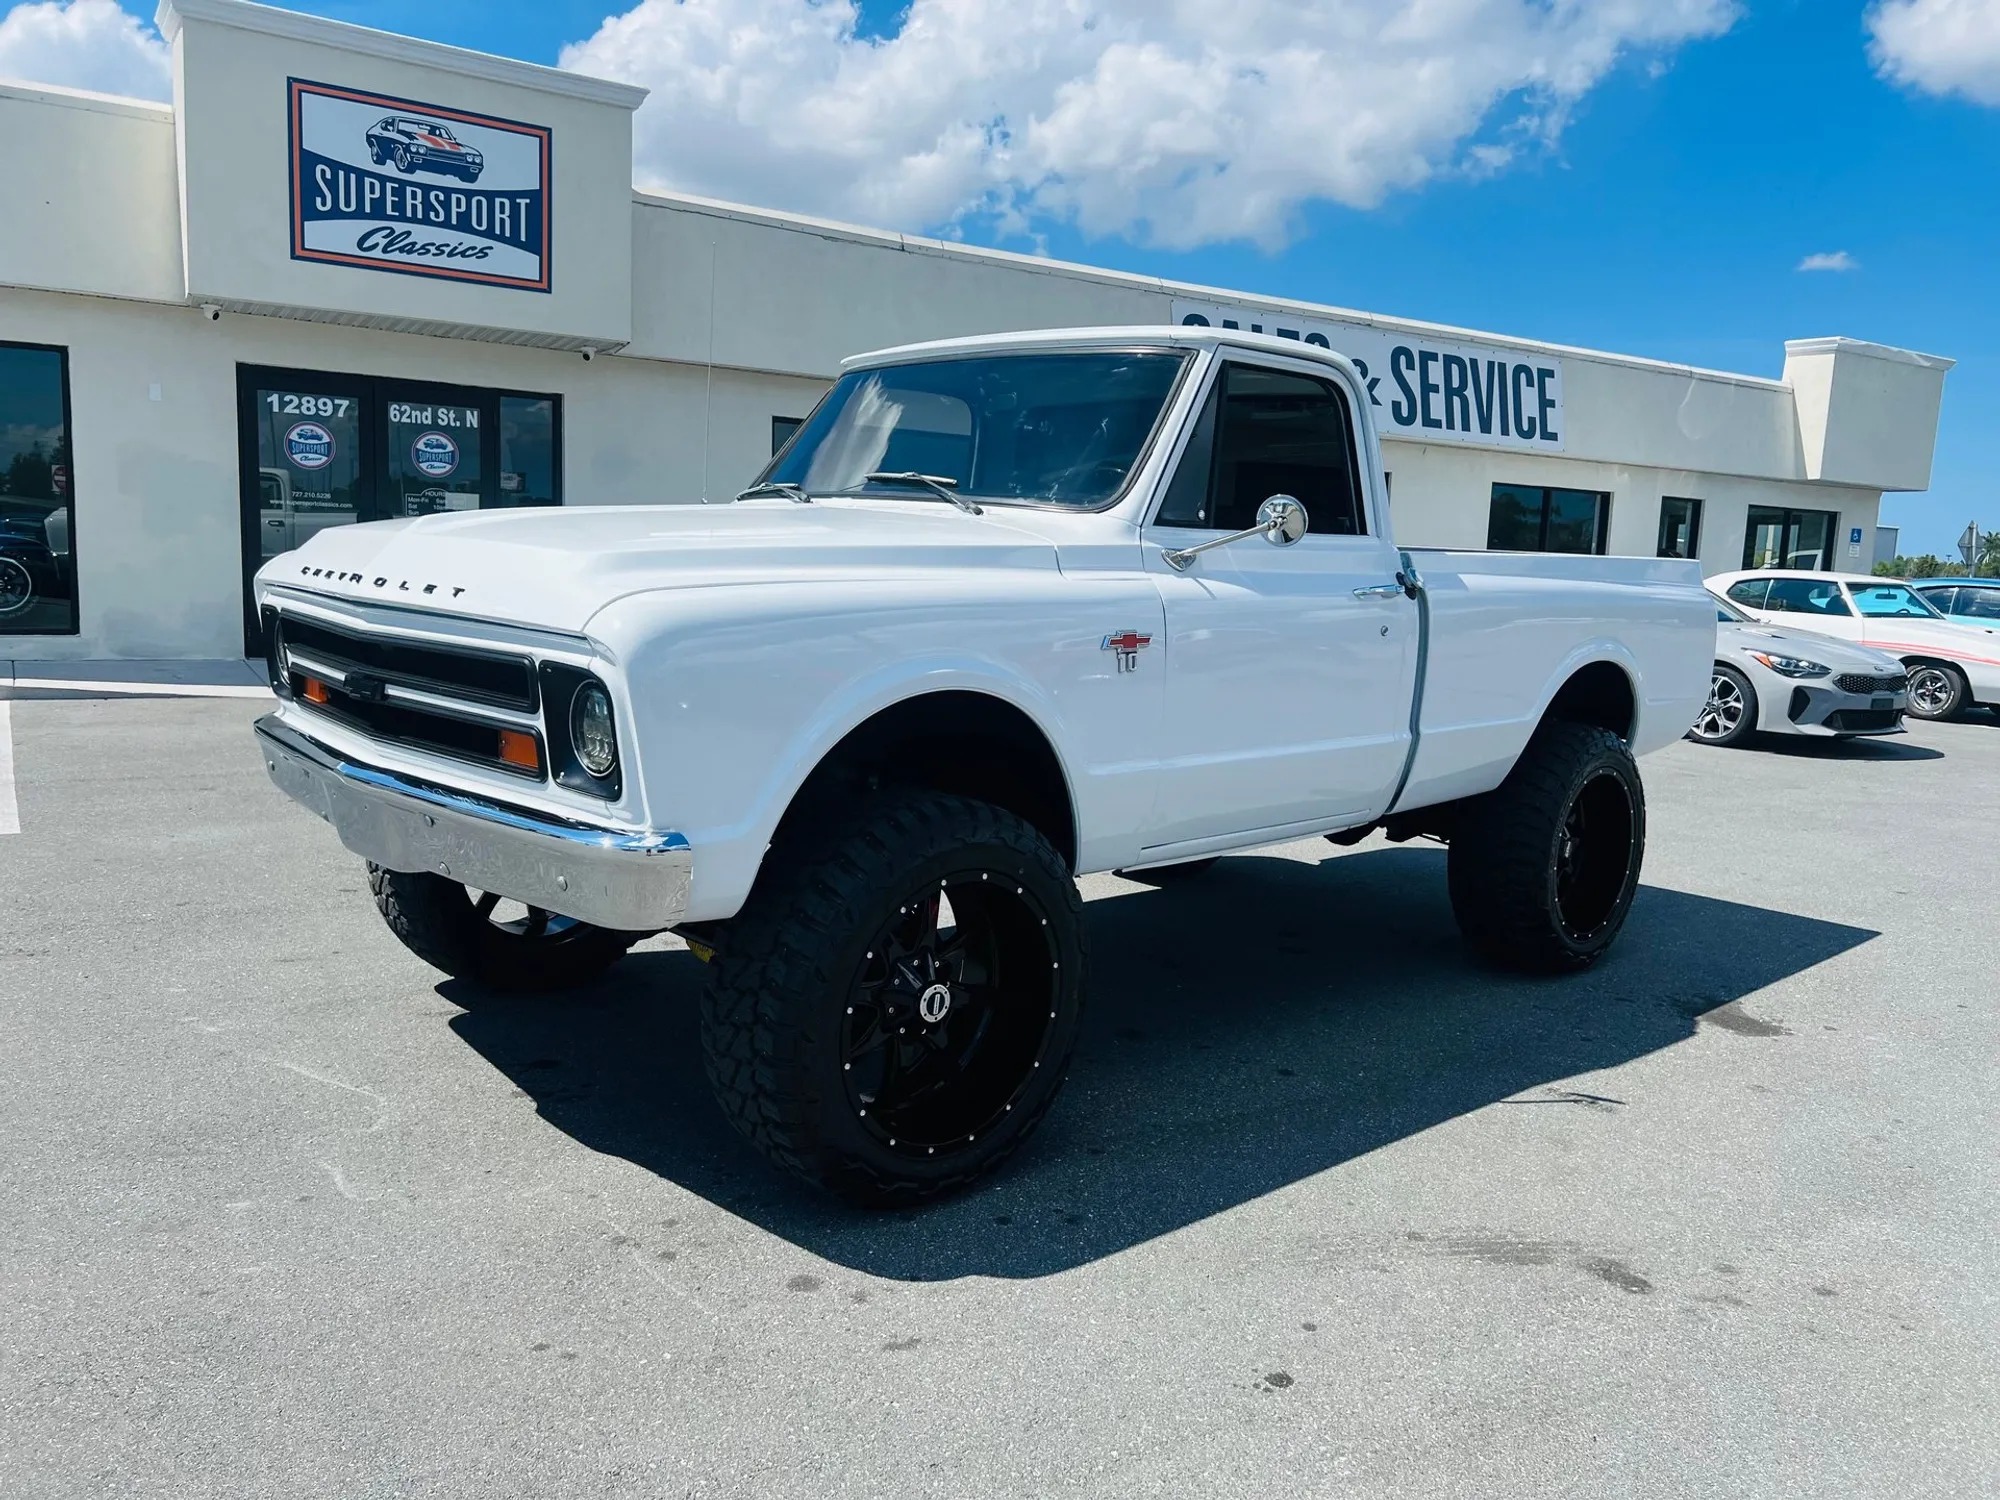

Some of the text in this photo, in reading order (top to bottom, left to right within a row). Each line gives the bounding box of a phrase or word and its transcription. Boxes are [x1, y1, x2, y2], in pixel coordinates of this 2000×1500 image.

[315, 164, 530, 242] SUPERSPORT
[356, 226, 494, 259] Classics
[267, 393, 350, 418] 12897
[1390, 345, 1559, 442] SERVICE
[390, 404, 479, 428] 62nd St. N
[291, 441, 328, 455] SUPERSPORT
[301, 566, 465, 598] CHEVROLET
